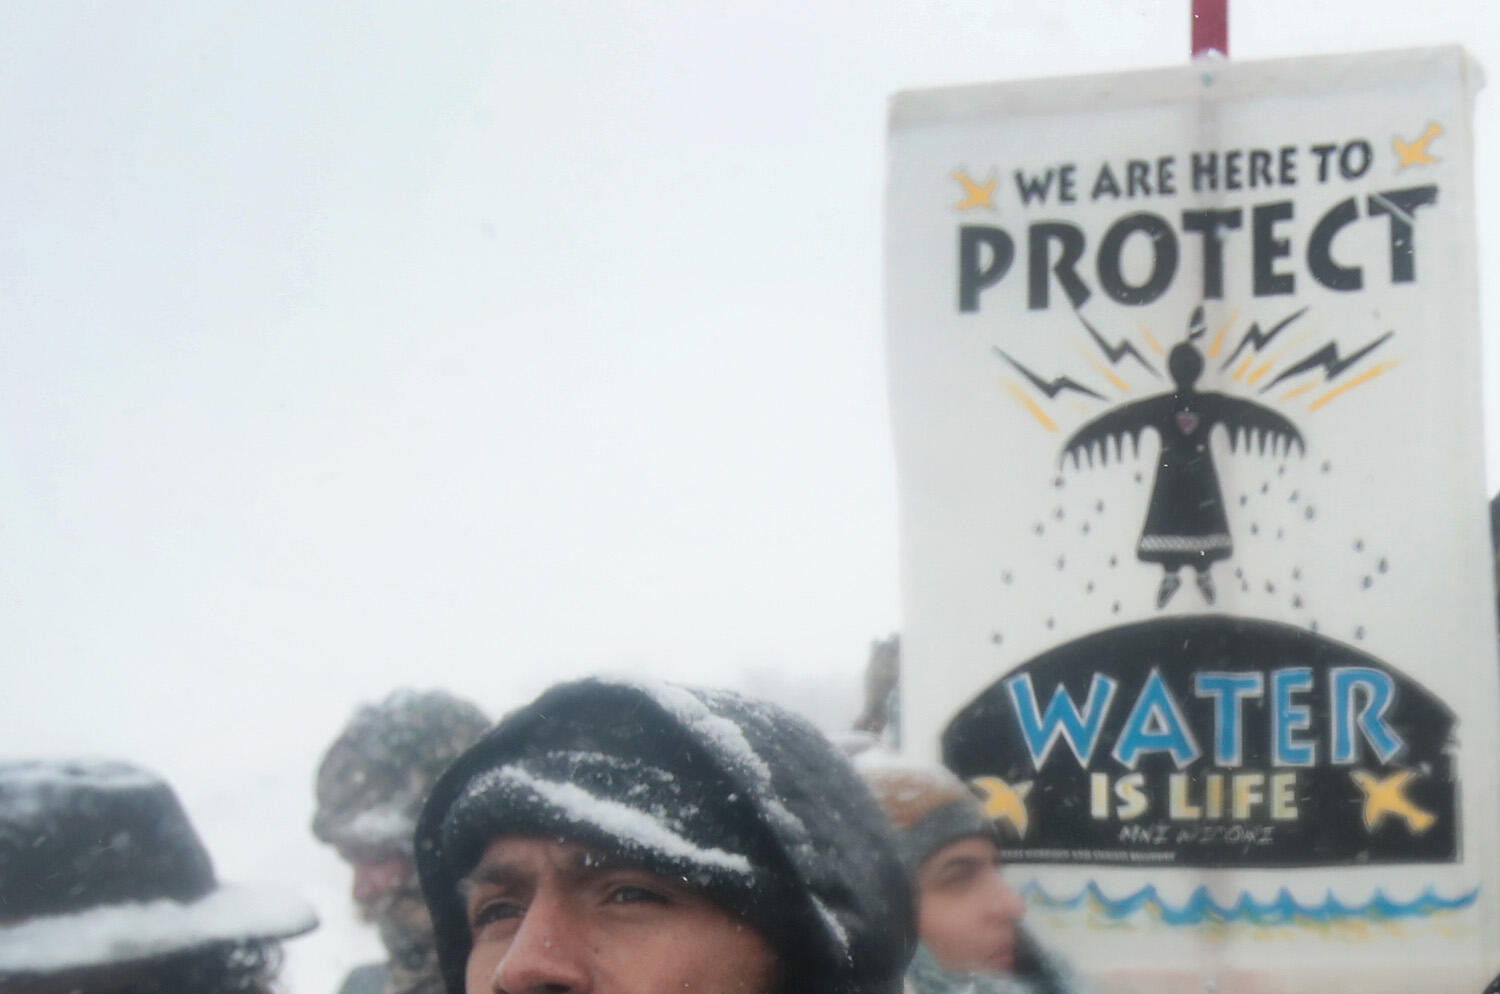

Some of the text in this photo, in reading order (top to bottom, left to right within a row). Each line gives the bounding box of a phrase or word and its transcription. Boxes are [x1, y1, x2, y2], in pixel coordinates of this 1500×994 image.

[1014, 139, 1373, 207] WE ARE HERE TO
[957, 184, 1438, 313] PROTECT
[1005, 667, 1404, 771] WATER
[1090, 772, 1299, 820] IS LIFE
